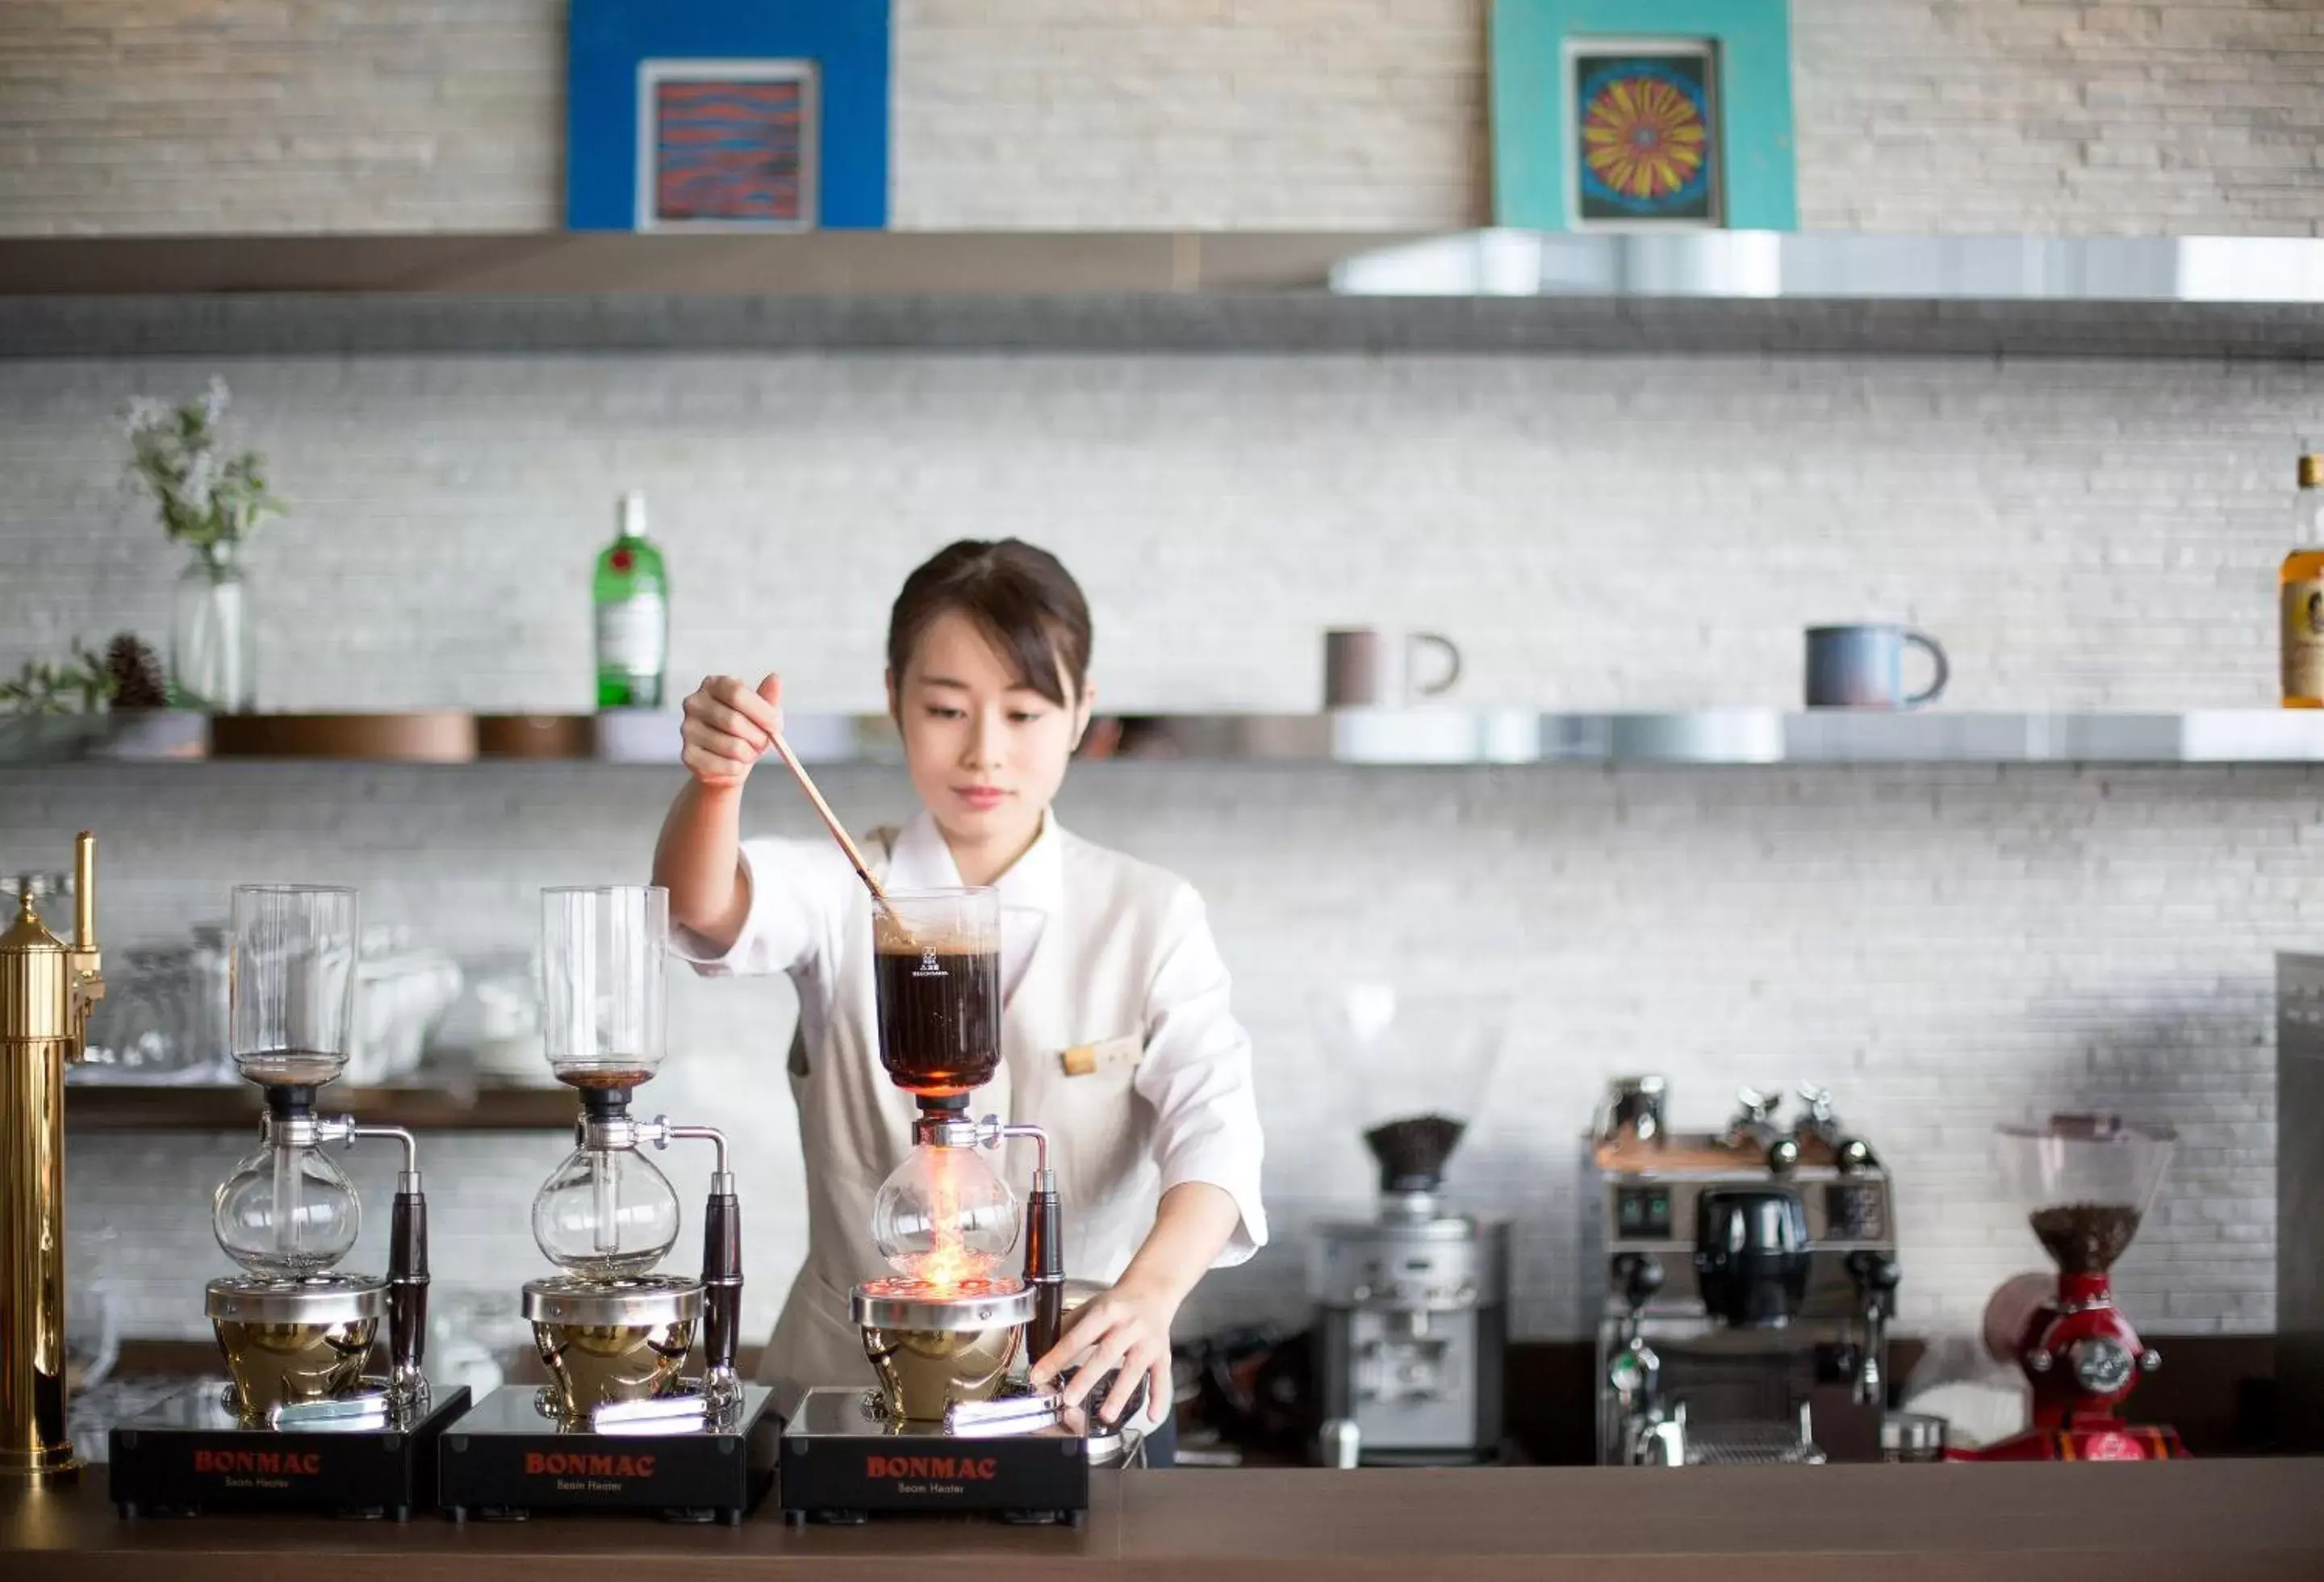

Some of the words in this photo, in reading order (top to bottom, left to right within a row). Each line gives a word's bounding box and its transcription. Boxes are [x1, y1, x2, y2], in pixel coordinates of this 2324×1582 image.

[194, 1450, 321, 1474] BONMAC
[526, 1453, 656, 1477] BONMAC
[867, 1455, 997, 1479] BONMAC
[557, 1479, 585, 1490] Beam
[588, 1480, 621, 1492] Heater
[898, 1482, 926, 1493] Beam
[930, 1483, 964, 1493] Heater
